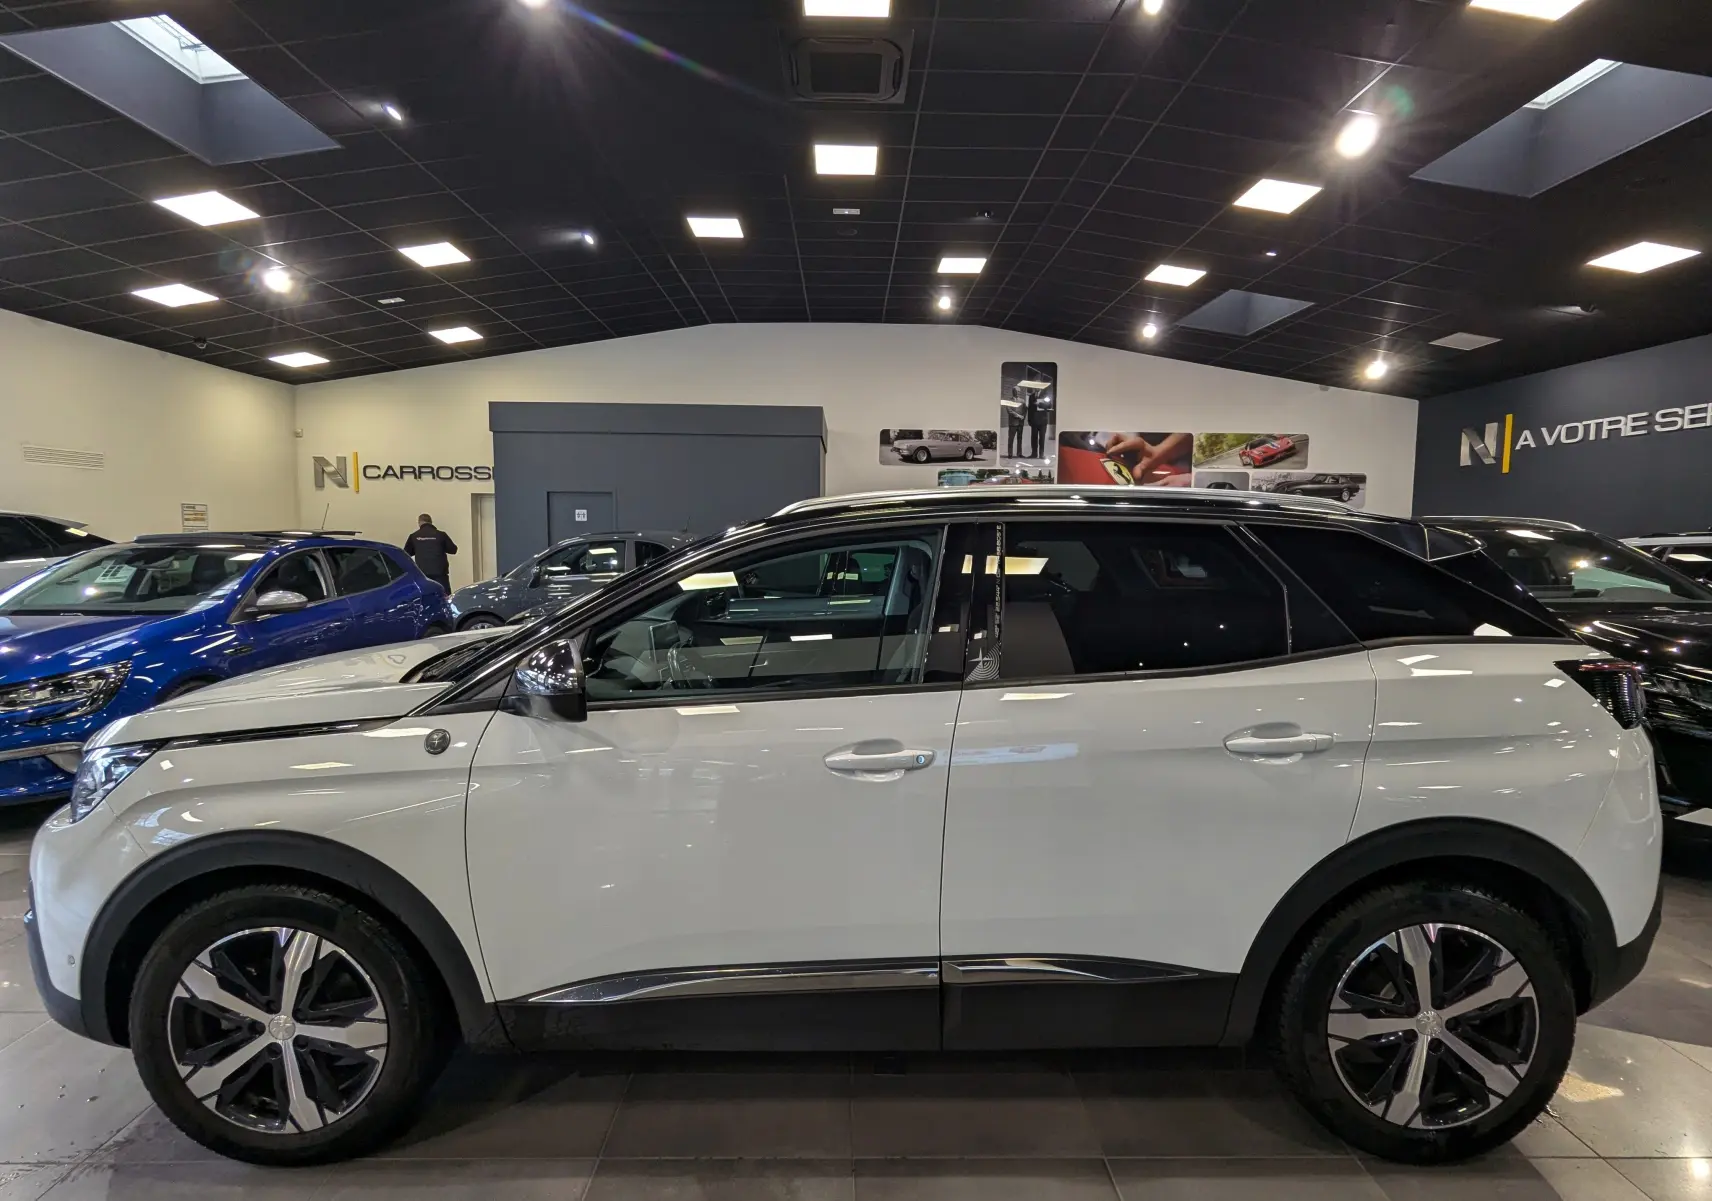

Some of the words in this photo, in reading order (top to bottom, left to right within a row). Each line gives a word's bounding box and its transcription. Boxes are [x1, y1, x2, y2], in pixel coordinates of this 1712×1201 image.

[1460, 422, 1499, 467] N
[1515, 429, 1536, 450] A
[1540, 411, 1650, 446] VOTRE
[1654, 402, 1712, 432] SE
[312, 456, 349, 488] N
[363, 465, 495, 480] CARROSS
